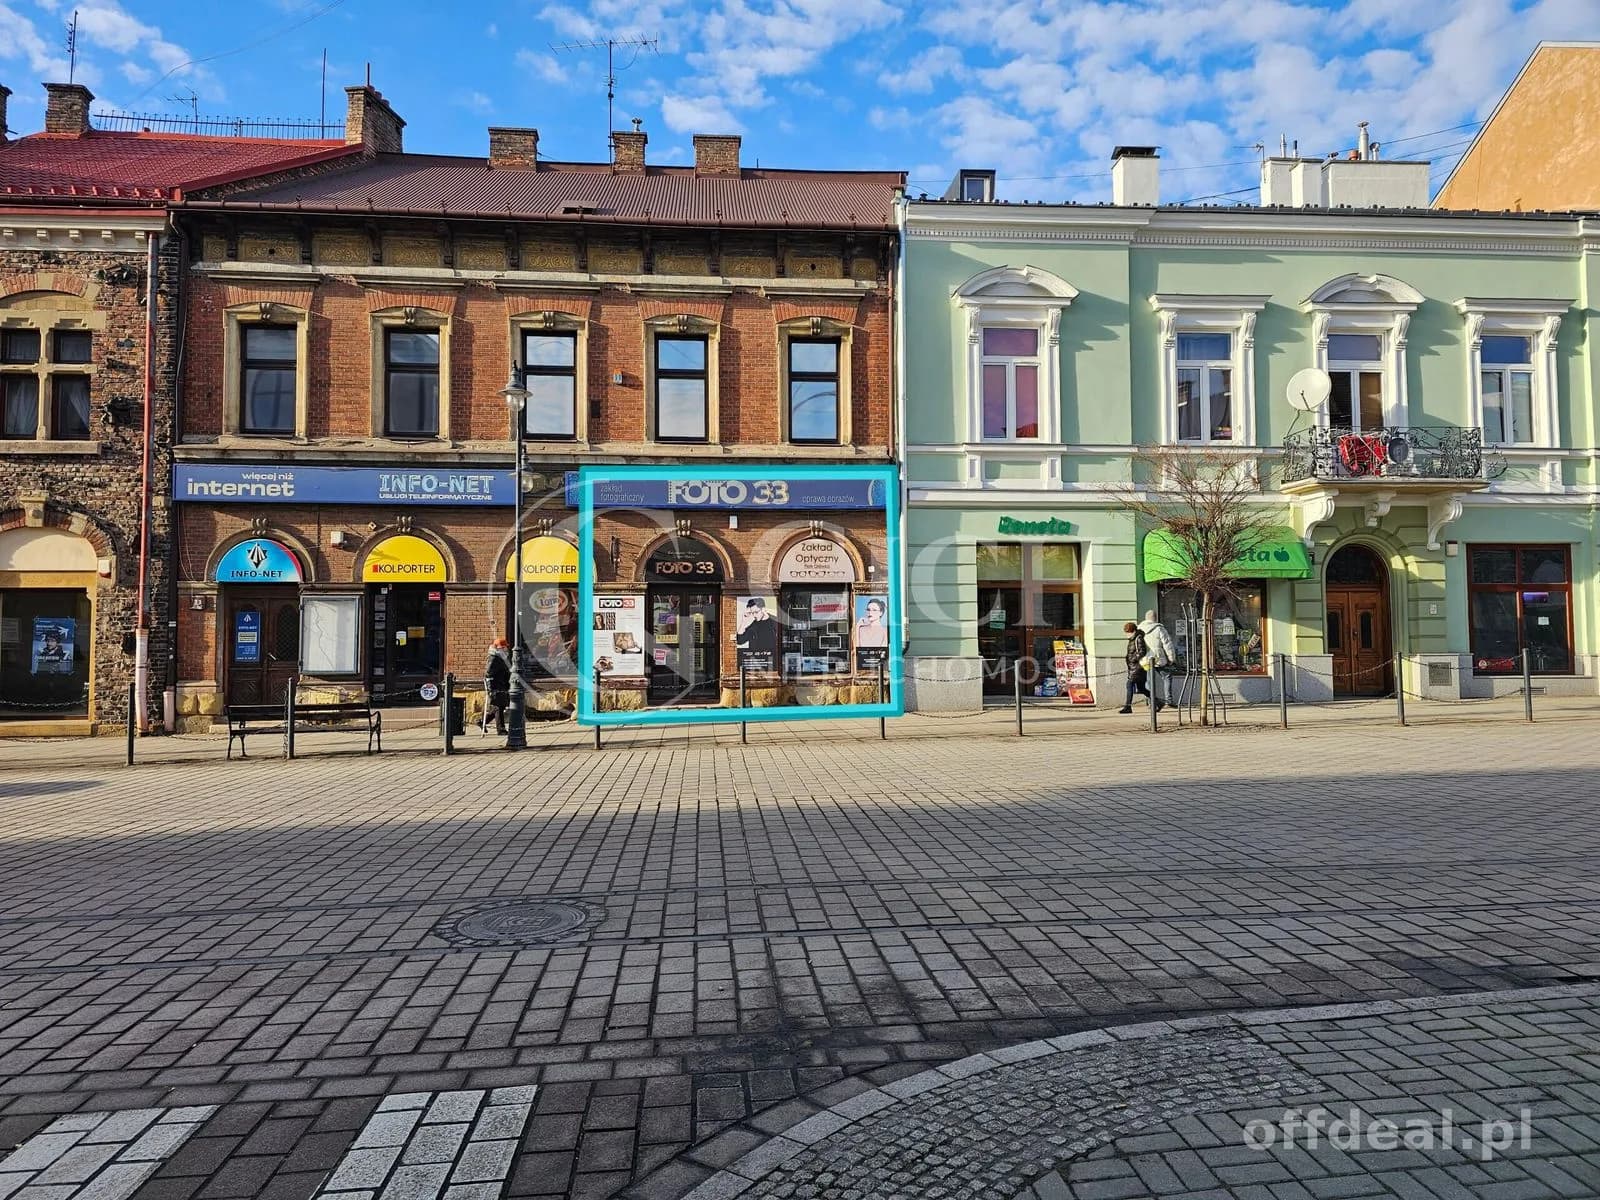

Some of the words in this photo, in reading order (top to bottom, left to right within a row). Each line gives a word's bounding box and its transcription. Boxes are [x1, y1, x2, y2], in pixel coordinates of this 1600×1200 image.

[242, 472, 276, 482] więcej
[278, 472, 294, 481] niż
[187, 478, 295, 497] internet
[379, 474, 495, 494] INFO-NET
[670, 480, 748, 504] FOTO
[752, 480, 789, 505] 33
[801, 543, 832, 552] Zakład
[795, 554, 839, 564] Optyczny
[378, 564, 435, 574] KOLPORTER
[655, 561, 693, 574] FOTO
[695, 561, 714, 574] 33
[230, 570, 283, 578] INFO-NET
[600, 599, 623, 608] FOTO
[623, 599, 635, 608] 33
